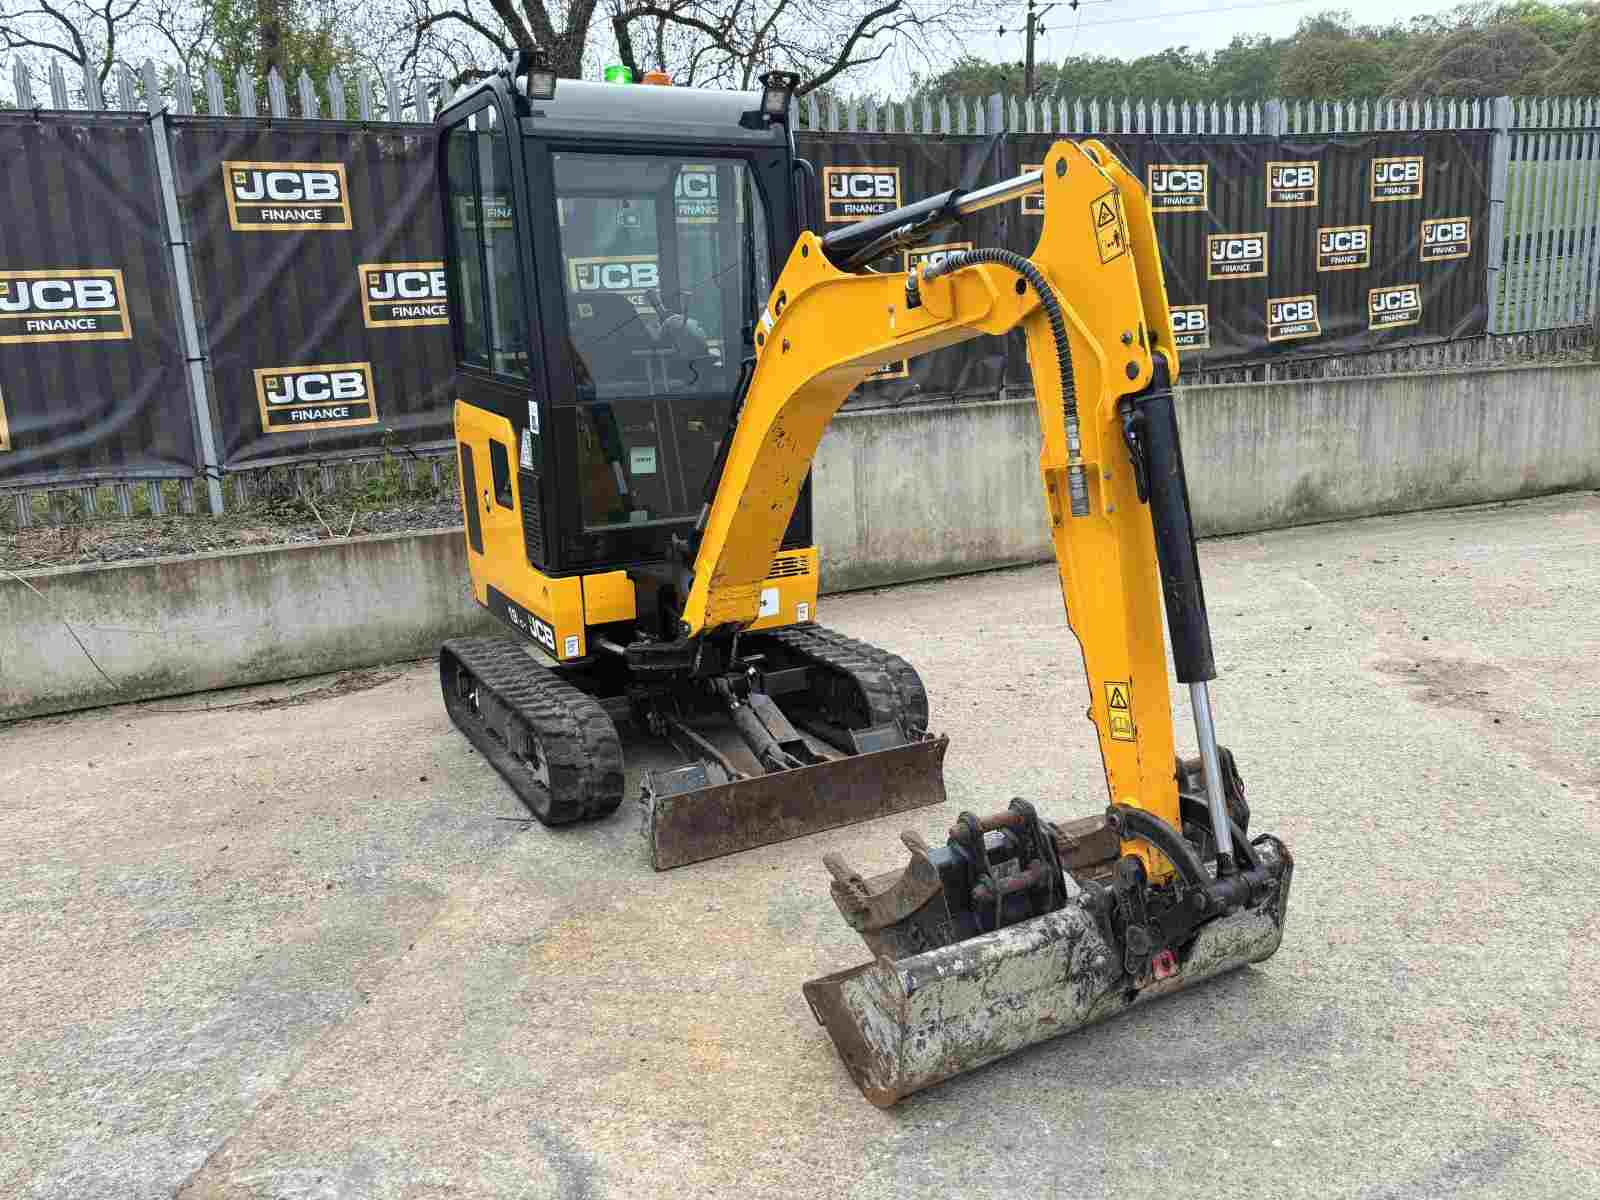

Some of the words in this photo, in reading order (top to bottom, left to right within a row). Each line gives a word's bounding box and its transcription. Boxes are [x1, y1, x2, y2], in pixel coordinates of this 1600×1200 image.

[1153, 171, 1203, 191] JCB
[1272, 168, 1313, 188] JCB
[1376, 163, 1419, 183] JCB
[236, 171, 340, 201] JCB
[831, 174, 895, 197] JCB
[1384, 186, 1411, 194] FINANCE
[1163, 196, 1195, 205] FINANCE
[1279, 192, 1305, 200] FINANCE
[261, 208, 322, 221] FINANCE
[844, 203, 884, 214] FINANCE
[1321, 231, 1367, 252] JCB
[1424, 223, 1466, 242] JCB
[1212, 240, 1262, 260] JCB
[1330, 255, 1357, 264] FINANCE
[1432, 246, 1457, 256] FINANCE
[579, 263, 660, 290] JCB
[1221, 264, 1251, 273] FINANCE
[1, 279, 116, 310] JCB
[369, 271, 447, 299] JCB
[1373, 290, 1417, 311] JCB
[391, 305, 447, 317] FINANCE
[1170, 311, 1205, 330] CB
[1271, 302, 1313, 322] JCB
[1380, 313, 1410, 322] FINANCE
[26, 318, 97, 332] FINANCE
[1279, 325, 1308, 334] FINANCE
[1175, 335, 1194, 344] ANCE
[267, 372, 366, 404] JCB
[291, 407, 349, 421] FINANCE
[530, 617, 555, 650] JCB
